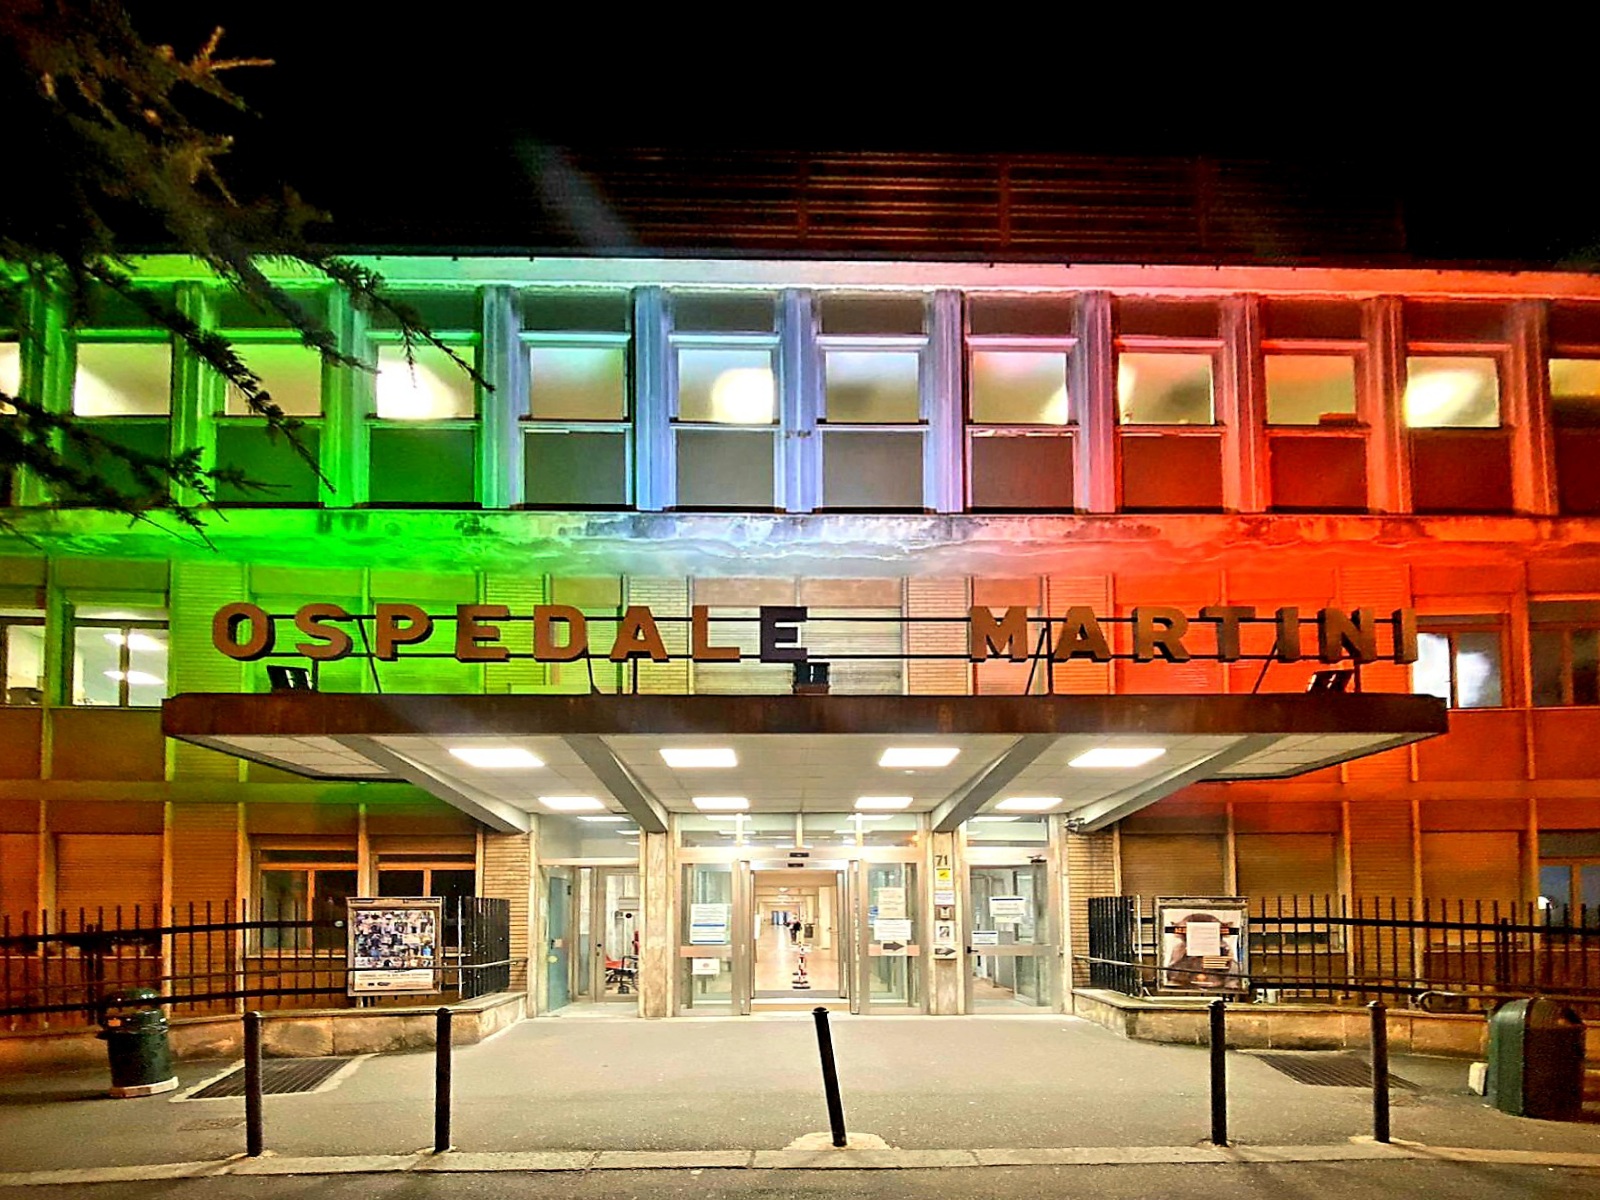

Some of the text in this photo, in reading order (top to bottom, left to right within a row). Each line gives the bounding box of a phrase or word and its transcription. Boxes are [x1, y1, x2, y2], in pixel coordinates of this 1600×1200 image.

[212, 603, 1418, 664] OSPEDALE MARTINI
[935, 855, 949, 866] 71
